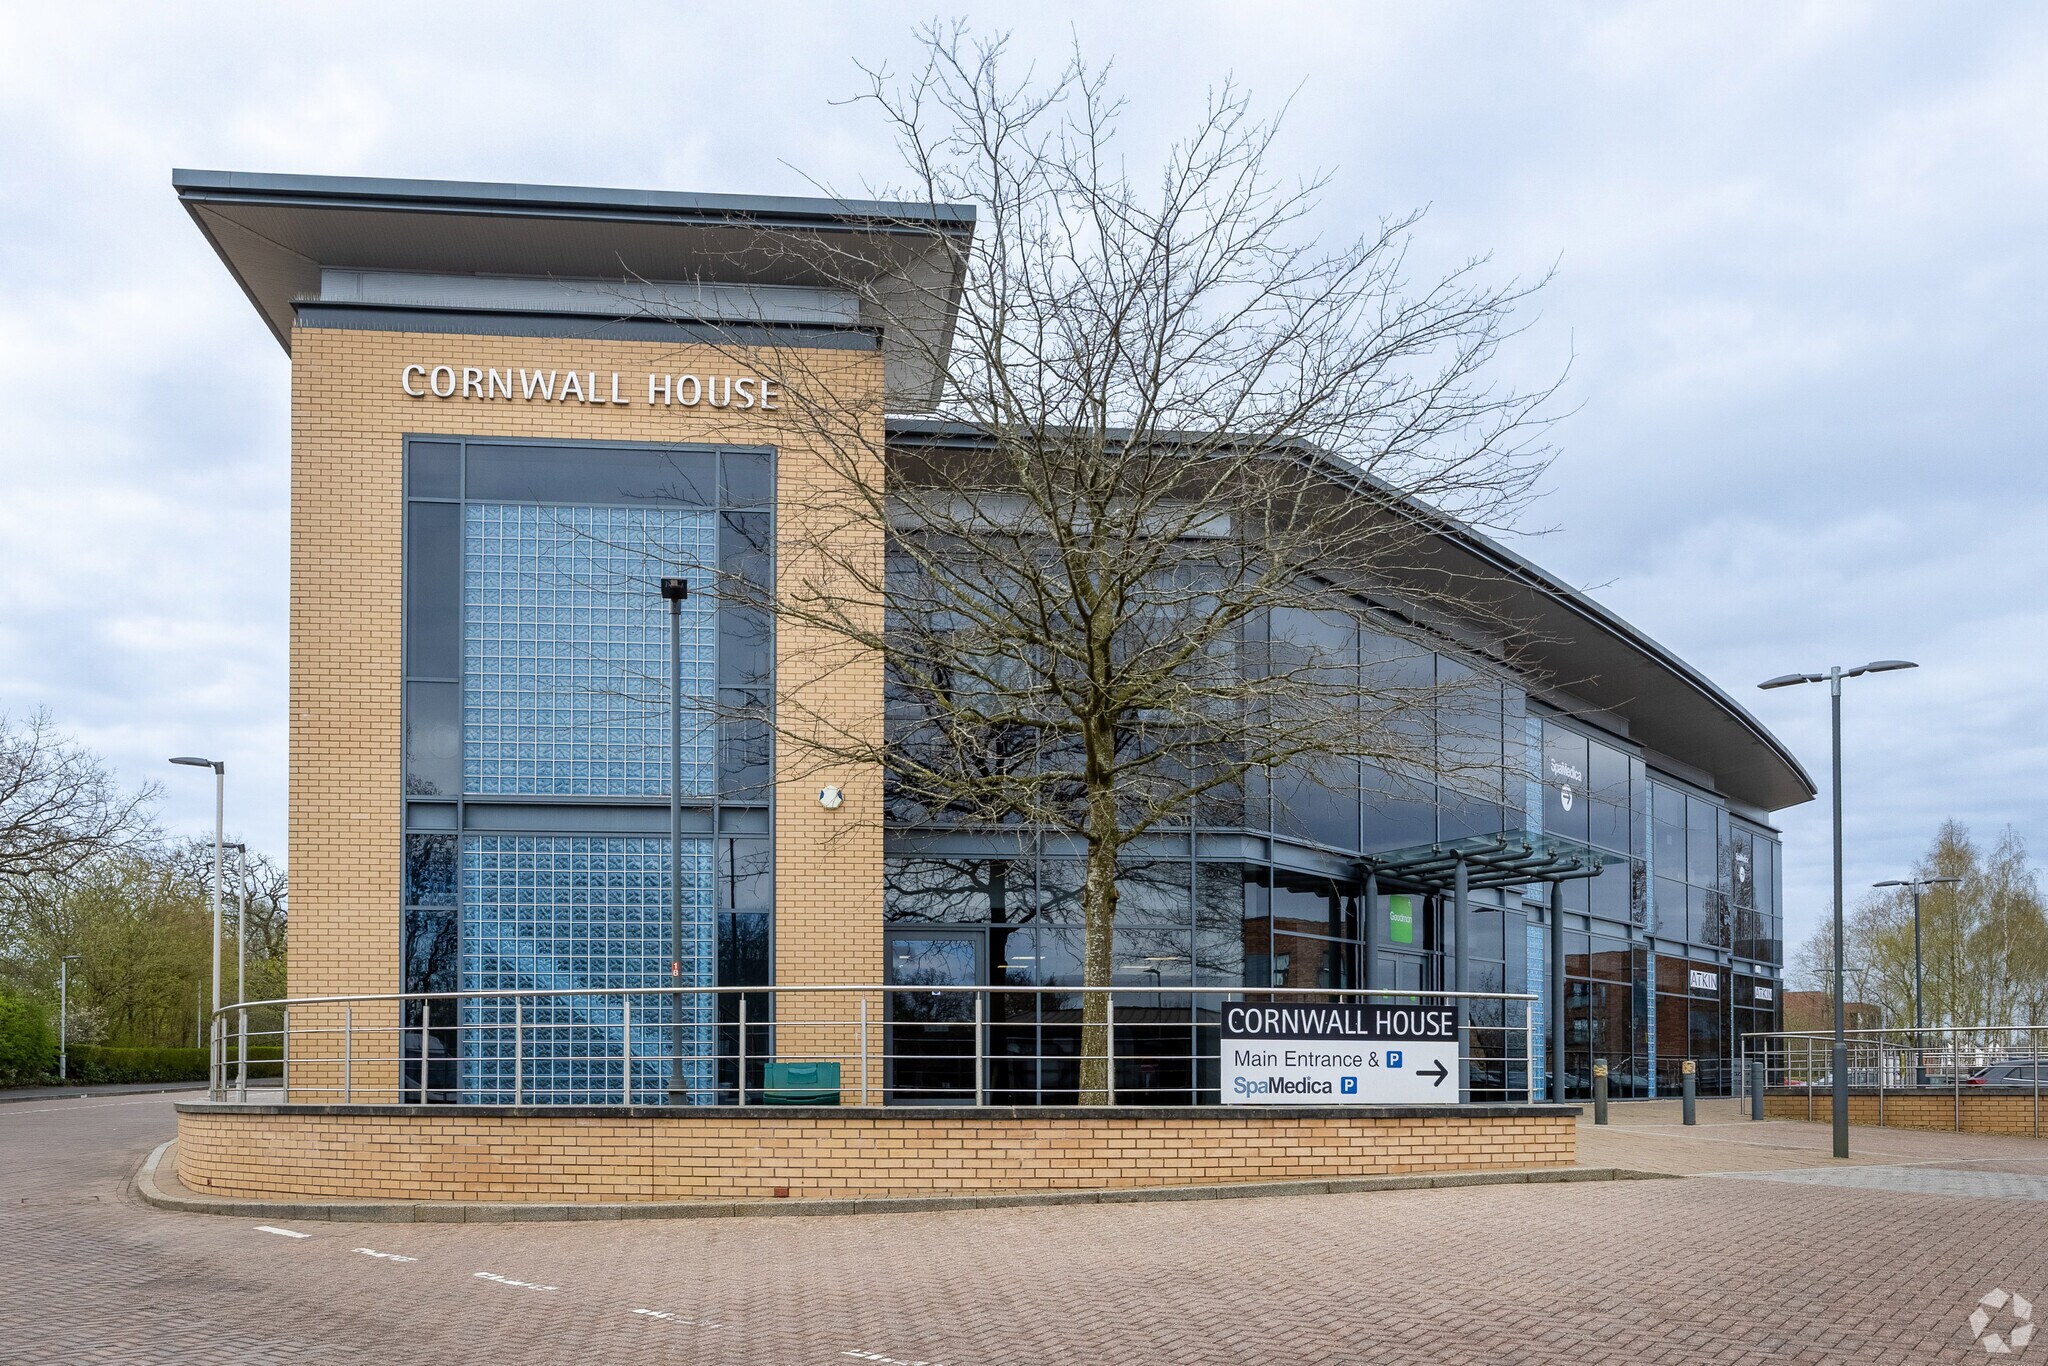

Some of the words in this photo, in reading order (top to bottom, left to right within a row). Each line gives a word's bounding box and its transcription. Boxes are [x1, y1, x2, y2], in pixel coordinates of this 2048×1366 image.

[401, 363, 630, 405] CORNWALL
[648, 372, 780, 411] HOUSE
[1390, 911, 1412, 924] Goodman
[1228, 1007, 1369, 1036] CORNWALL
[1376, 1010, 1453, 1036] HOUSE
[1234, 1050, 1278, 1067] Main
[1284, 1051, 1363, 1068] Entrance
[1368, 1051, 1380, 1068] &
[1389, 1053, 1400, 1066] P
[1233, 1076, 1333, 1098] SpaMedica
[1344, 1079, 1354, 1092] P
